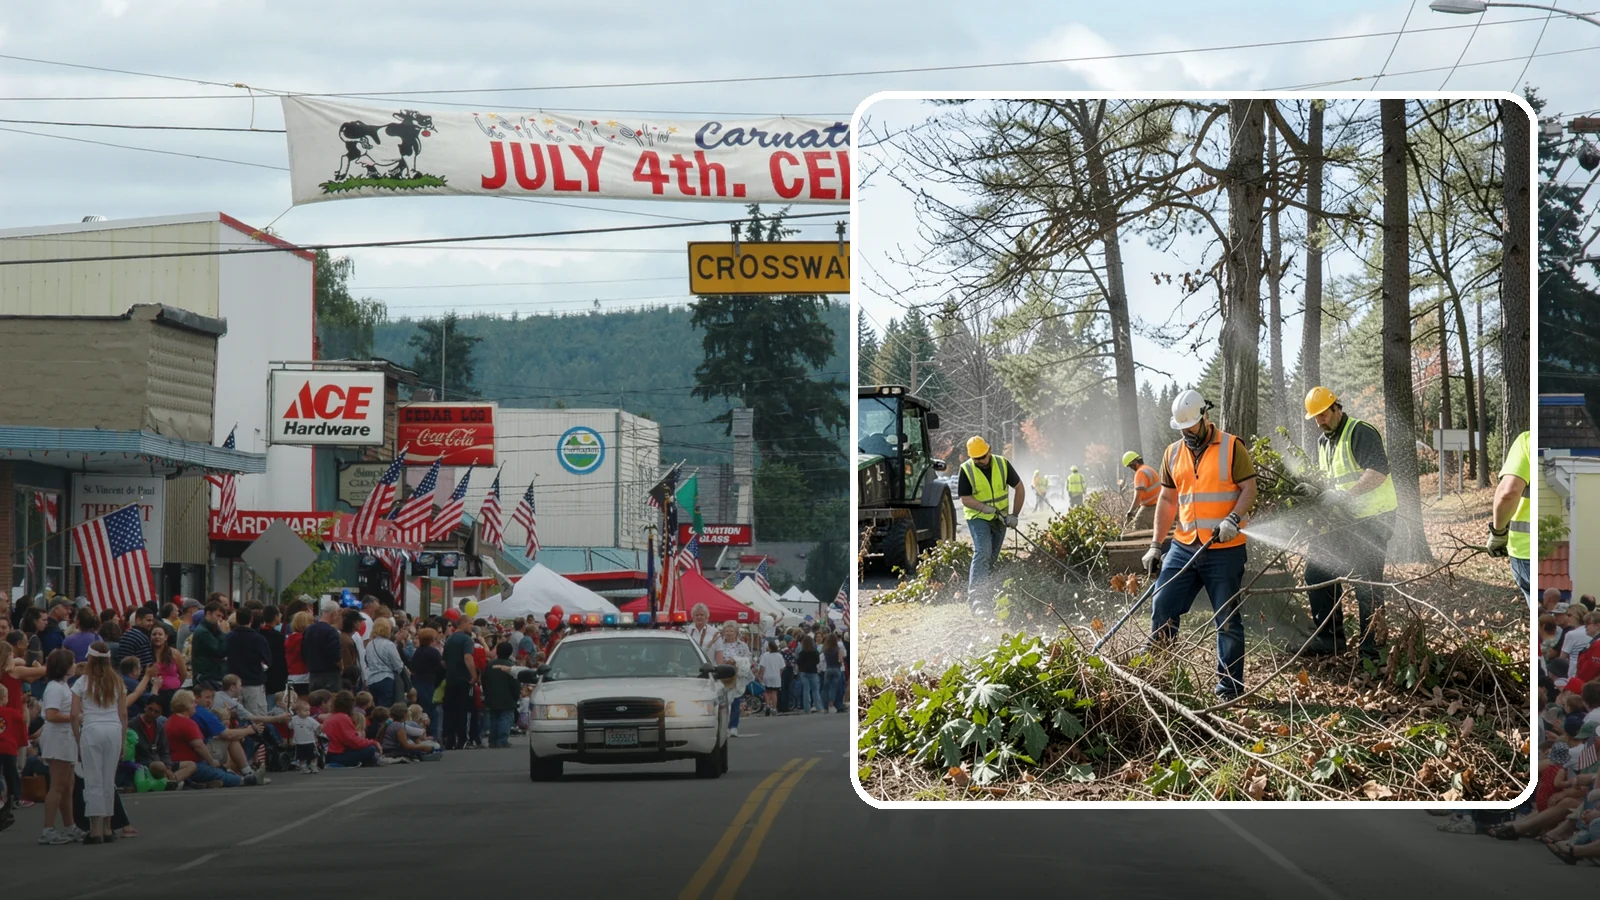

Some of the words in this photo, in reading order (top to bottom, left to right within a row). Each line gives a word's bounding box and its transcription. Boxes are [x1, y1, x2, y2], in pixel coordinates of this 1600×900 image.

[481, 141, 605, 192] JULY
[632, 149, 746, 198] 4th.
[697, 254, 850, 280] CROSSWA
[283, 380, 374, 420] ACE
[405, 409, 453, 421] CEDAR
[283, 421, 371, 437] Hardware
[416, 428, 476, 447] Coca-Cola
[95, 485, 124, 494] Vincent
[126, 486, 135, 494] de
[137, 486, 155, 495] Paul
[688, 526, 741, 535] CRNATION
[699, 535, 730, 543] GLASS
